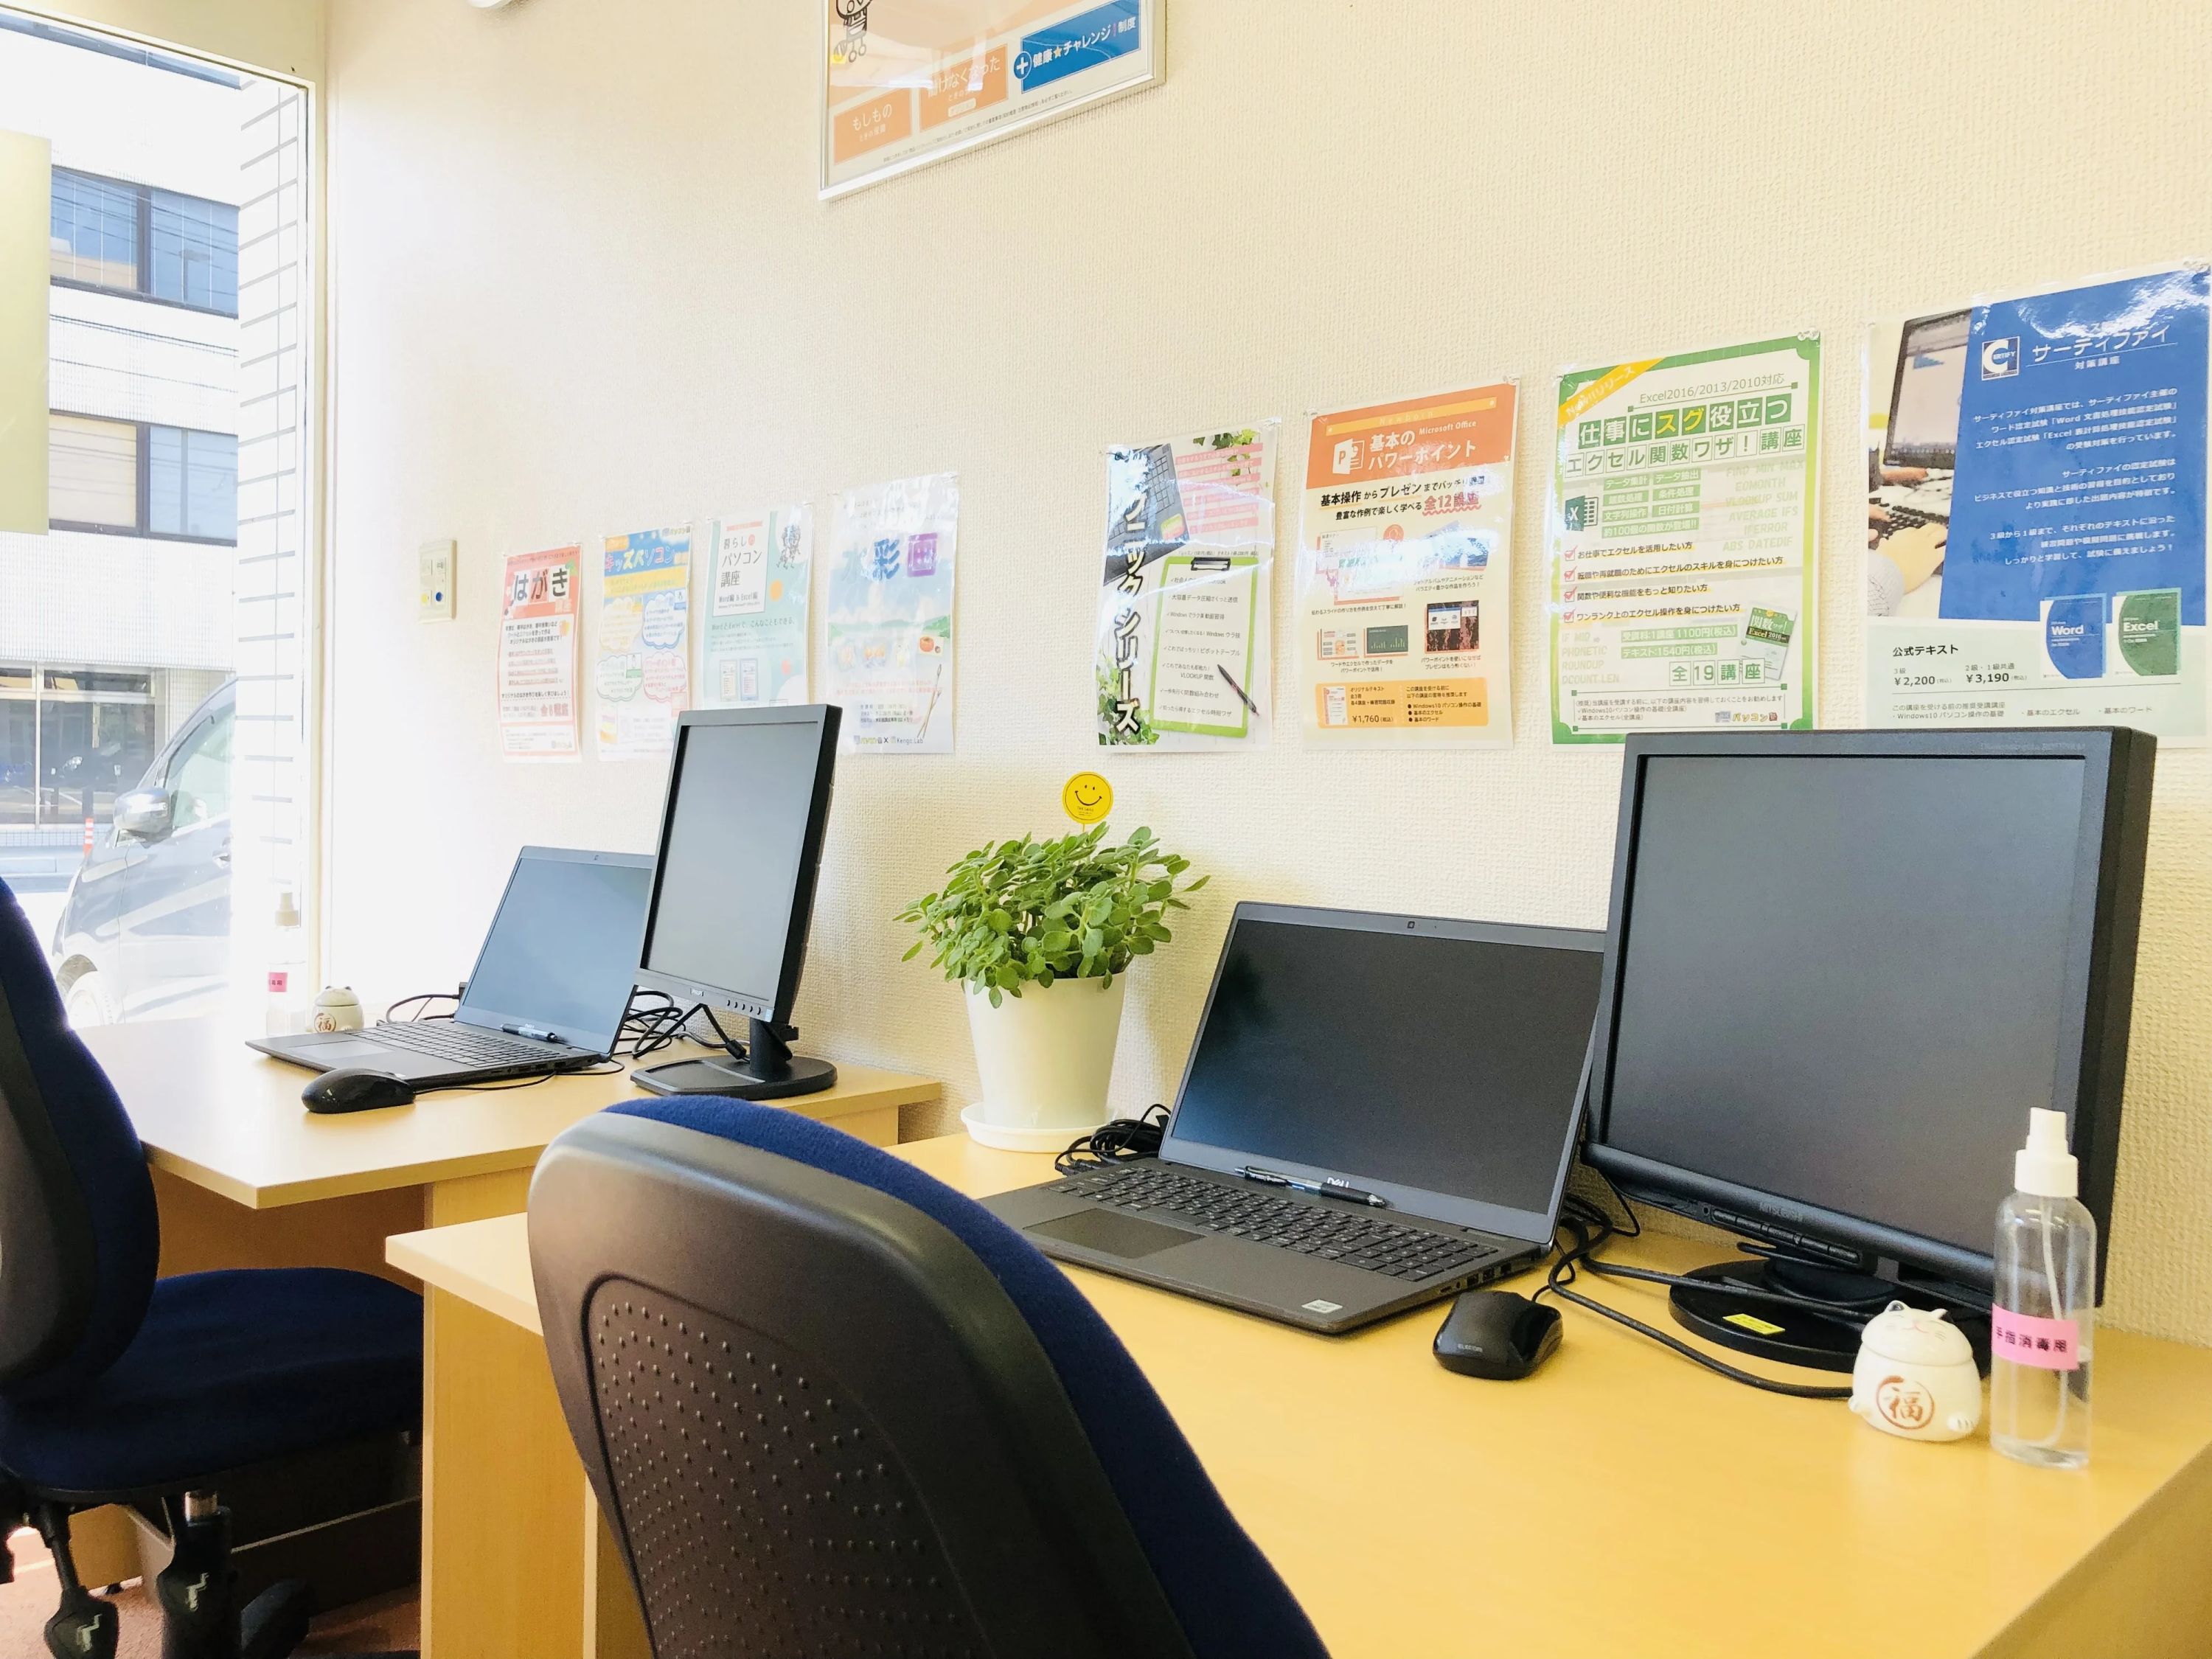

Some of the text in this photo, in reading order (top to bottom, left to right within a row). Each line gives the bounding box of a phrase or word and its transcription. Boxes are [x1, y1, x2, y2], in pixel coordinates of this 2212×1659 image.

[852, 103, 892, 131] もしもの
[1639, 373, 1785, 404] Excel2016/2013/2010対応
[1419, 420, 1477, 436] Microsoft Office
[1579, 399, 1789, 447] 仕事にスグ役立つ
[1369, 430, 1416, 452] 基本の
[1368, 439, 1477, 470] パワーポイント
[1776, 490, 1798, 502] SUM
[722, 550, 762, 568] パソコン
[1577, 542, 1693, 559] お仕事でエクセルを活用したい方
[514, 568, 568, 601] はがき
[720, 570, 741, 588] 講座
[1576, 584, 1708, 601] 関数や便利な機能をもっと知りたい方
[1576, 603, 1740, 620] ワンランク上のエクセル操作を身につけたい方
[2051, 625, 2084, 636] Word
[2124, 620, 2159, 632] Excel
[1893, 644, 1958, 657] 公式テキスト
[1672, 663, 1761, 682] 全19講座
[1883, 1385, 1924, 1422] 福
